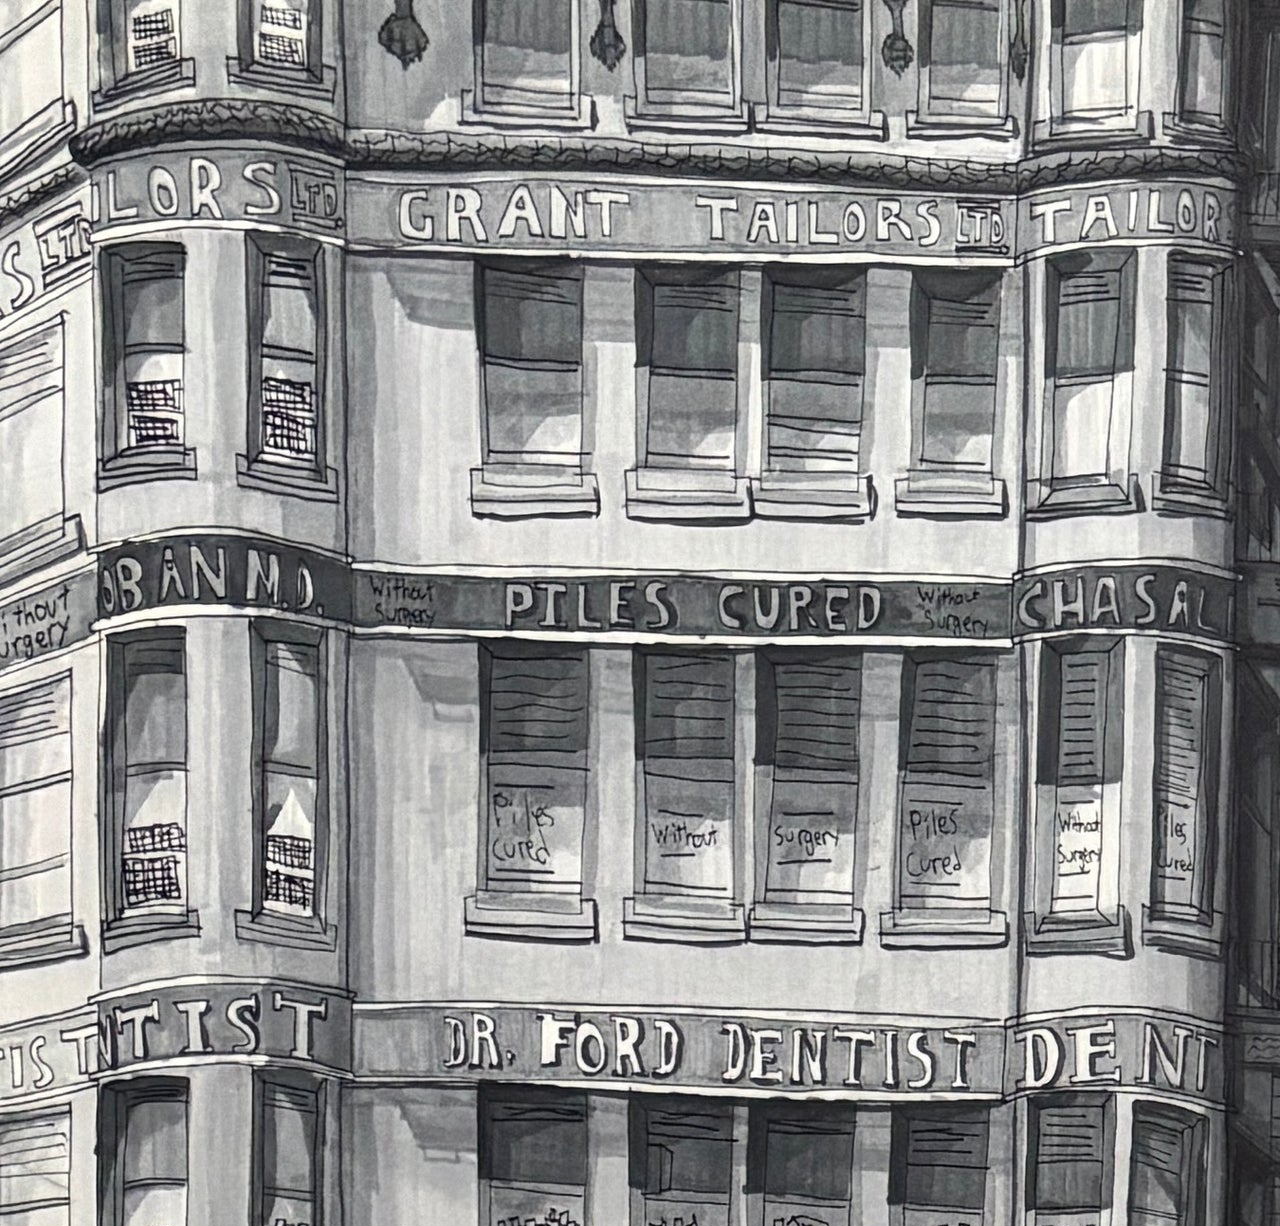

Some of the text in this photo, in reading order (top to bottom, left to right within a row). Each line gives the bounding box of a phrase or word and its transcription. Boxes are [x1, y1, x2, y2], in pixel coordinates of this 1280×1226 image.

[399, 186, 629, 243] GRANT
[696, 196, 940, 246] TAILORS
[0, 585, 71, 634] ithout
[506, 582, 882, 632] PILES CURED
[775, 826, 839, 856] Surgery
[909, 809, 958, 840] Piles
[443, 1012, 978, 1089] DR. FORD DENTIST
[1016, 1021, 1218, 1091] DENT
